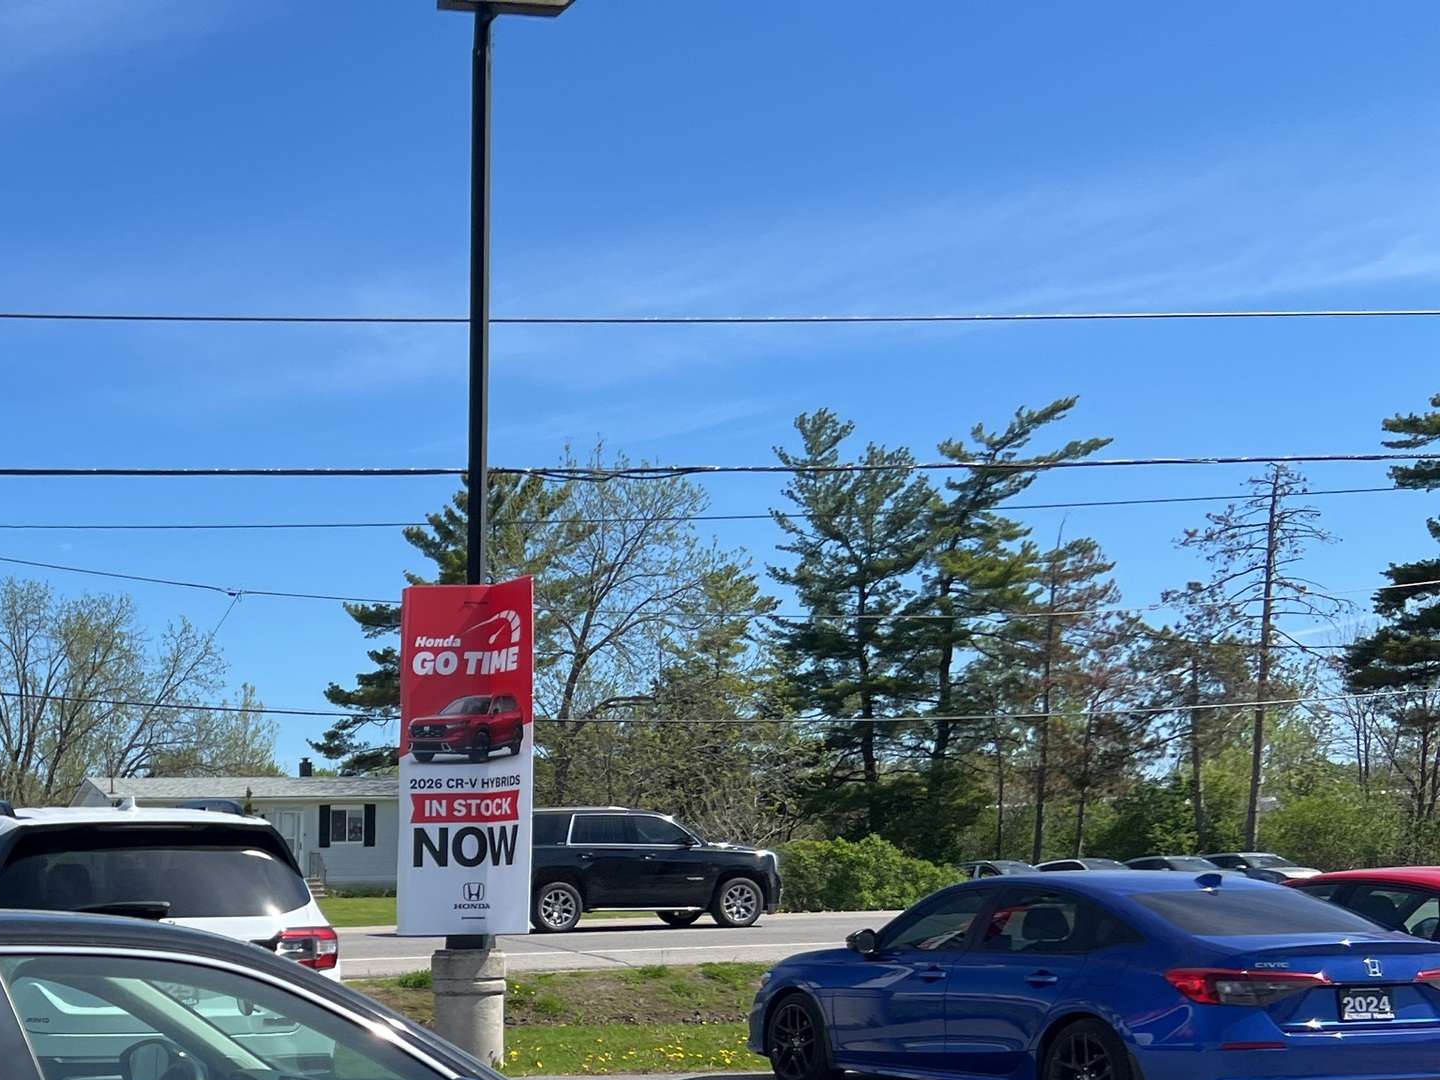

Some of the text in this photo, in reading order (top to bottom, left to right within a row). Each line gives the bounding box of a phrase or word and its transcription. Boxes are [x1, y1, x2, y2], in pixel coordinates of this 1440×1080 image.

[415, 634, 461, 648] Honda
[412, 646, 520, 676] GO TIME
[410, 775, 521, 790] 2026 CR-V HYBRIDS
[424, 797, 513, 817] IN STOCK
[413, 824, 519, 868] NOW
[1342, 996, 1391, 1012] 2024
